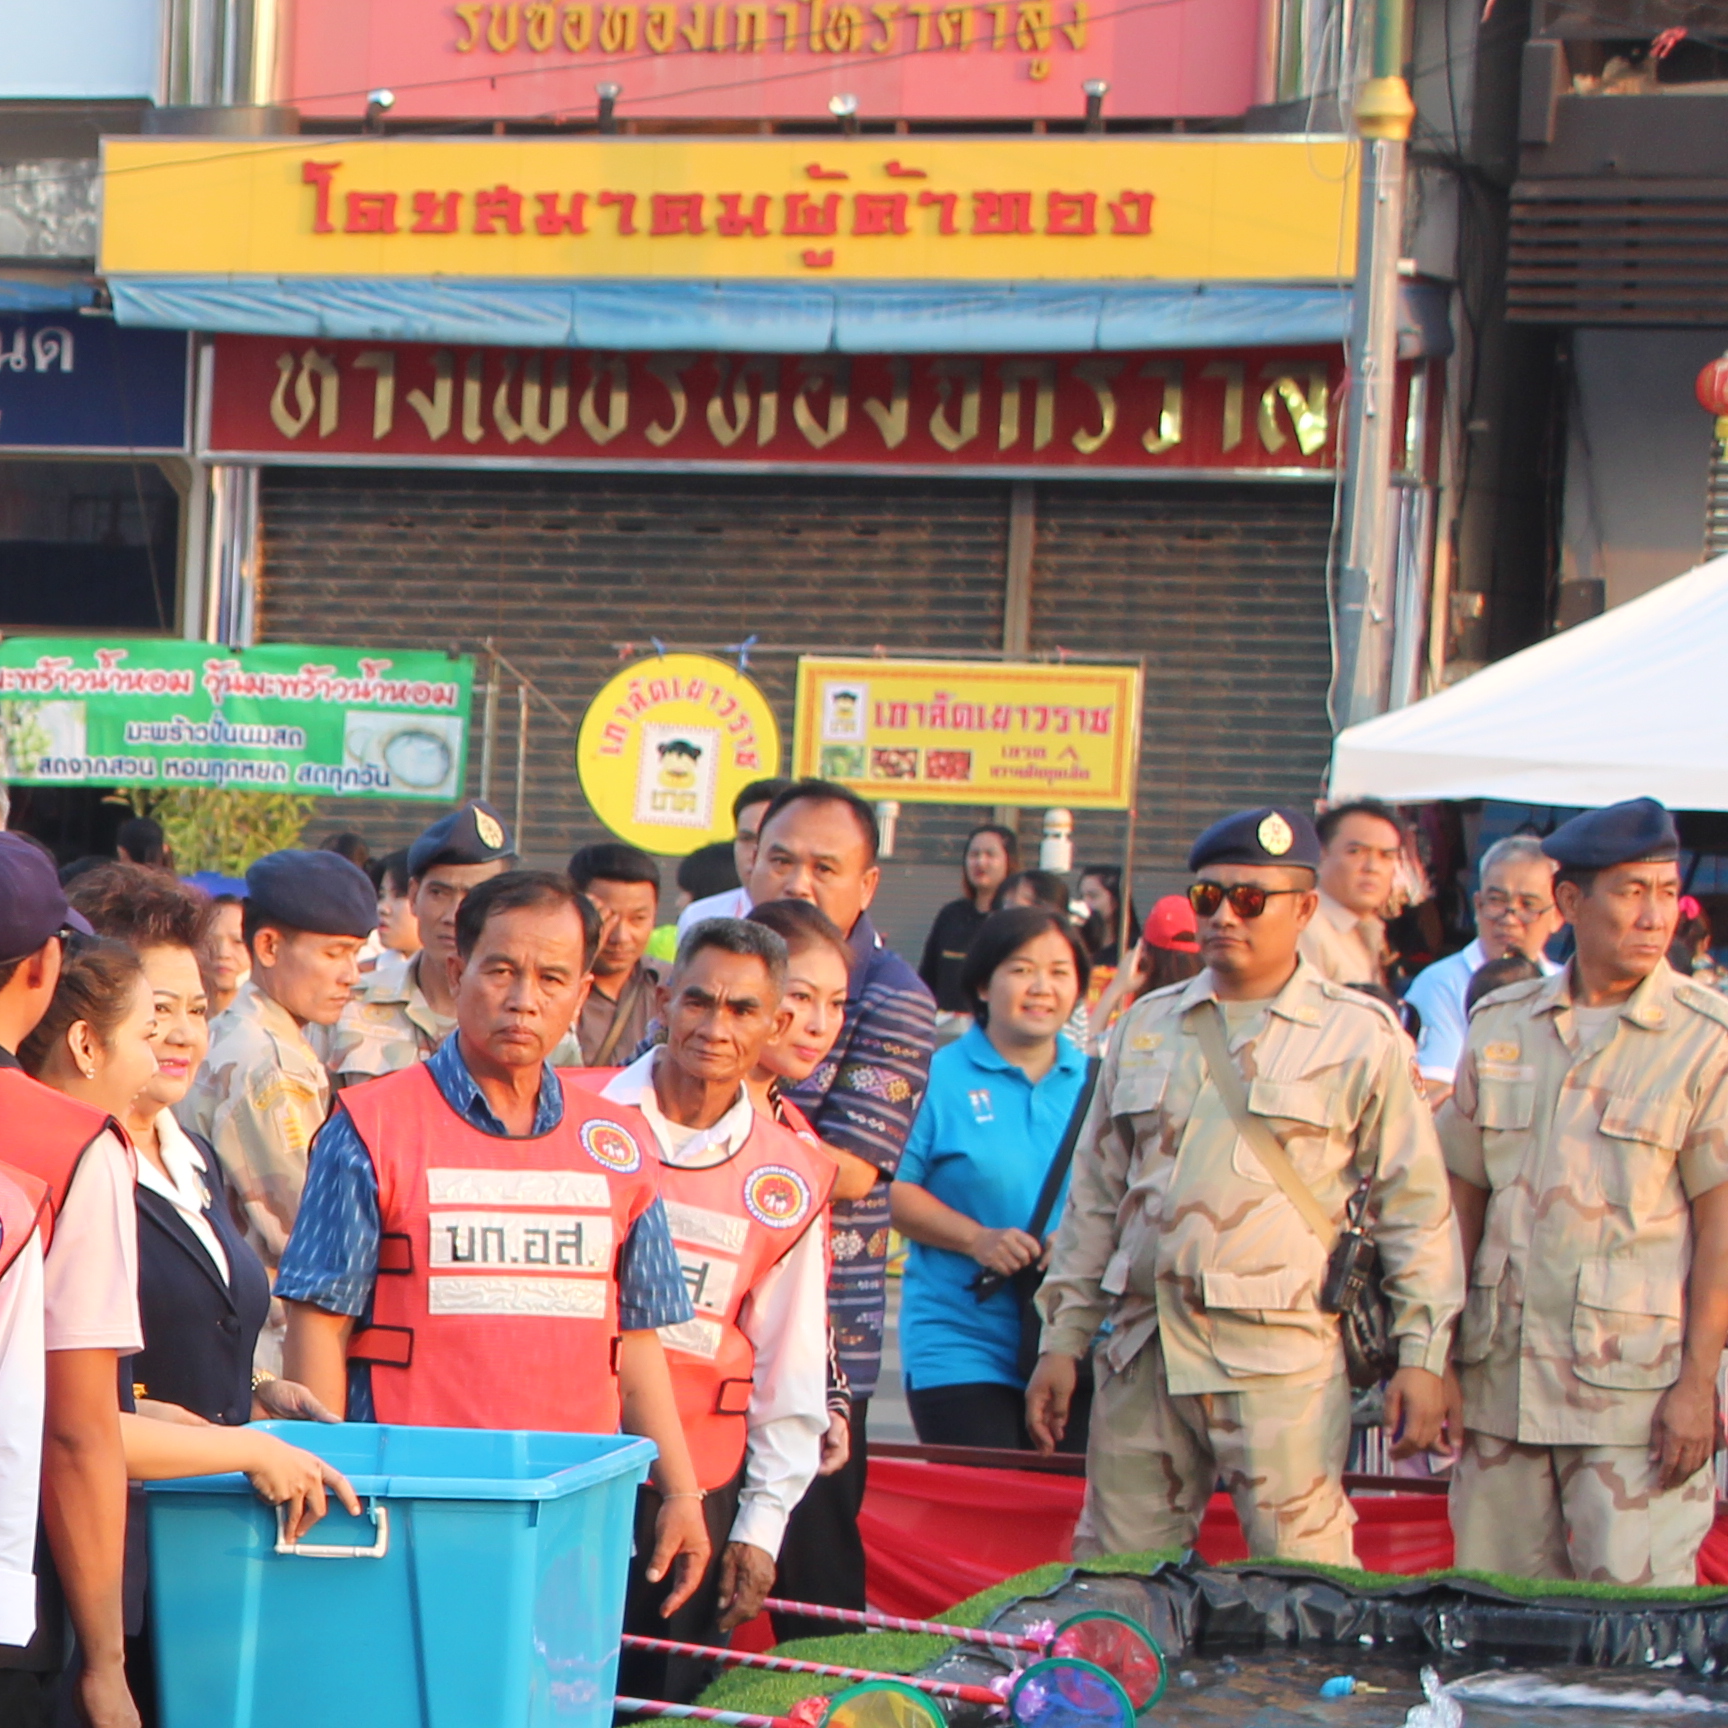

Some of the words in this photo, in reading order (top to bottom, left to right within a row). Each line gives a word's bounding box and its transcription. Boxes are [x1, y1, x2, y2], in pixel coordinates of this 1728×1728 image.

[454, 0, 1089, 80] รบซอทองเกาใหราคาสูง
[301, 160, 1155, 268] โดยสมาคมผู้ค้าทอง
[269, 347, 1330, 457] หางเพชรทองจกรวาล
[37, 754, 155, 780] สดจากสวน
[163, 760, 287, 788] หอมทุกหยด
[295, 761, 392, 795] สดทุกวัน
[446, 1221, 596, 1266] บก.อส.
